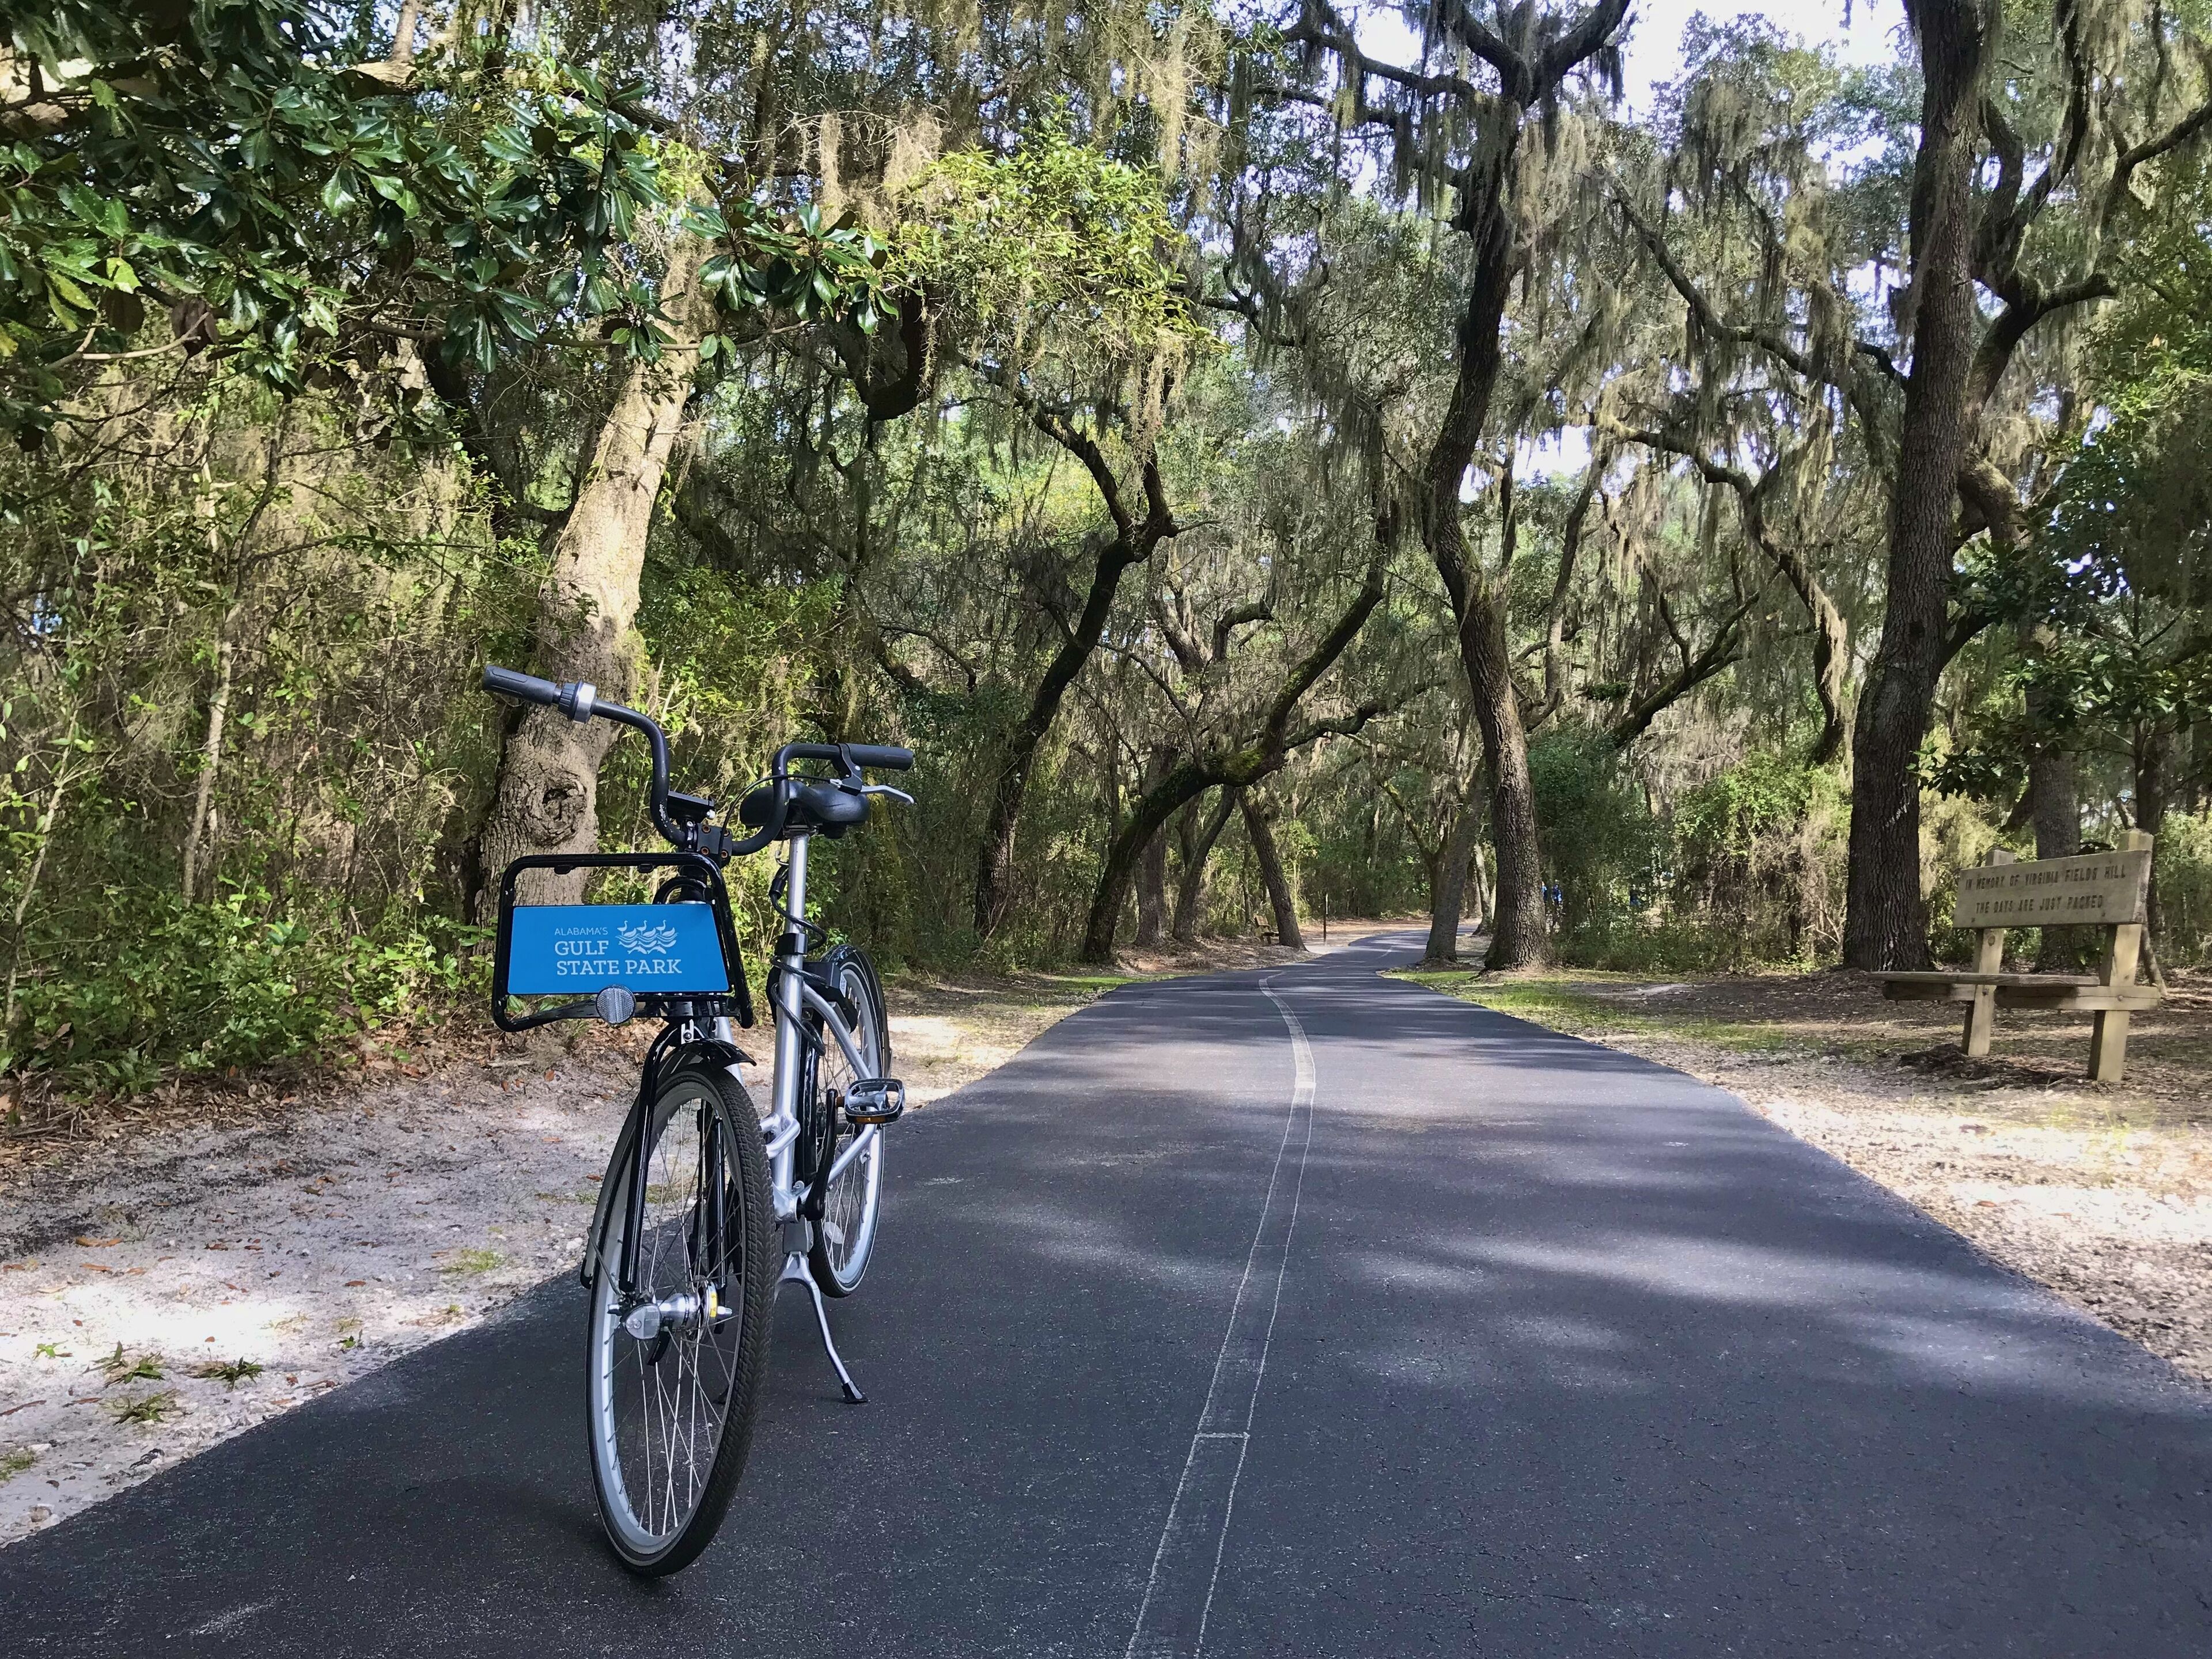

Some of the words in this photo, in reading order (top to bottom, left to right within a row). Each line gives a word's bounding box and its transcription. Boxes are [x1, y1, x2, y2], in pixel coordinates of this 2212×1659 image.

[1965, 878, 1973, 890] IN
[1976, 876, 2005, 890] MEMORY
[2009, 874, 2020, 887] OF
[2025, 870, 2059, 886] VIRGINIA
[2065, 867, 2098, 882] FIELDS
[2104, 864, 2126, 880] HILL
[1976, 902, 1990, 914] THE
[1993, 900, 2013, 914] DAYS
[2018, 899, 2035, 912] ARE
[2039, 895, 2062, 911] JUST
[2067, 895, 2103, 910] PACKED
[554, 927, 609, 936] ALABAMA'S
[554, 940, 609, 956] GULF
[556, 960, 620, 976] STATE
[625, 959, 683, 975] PARK
